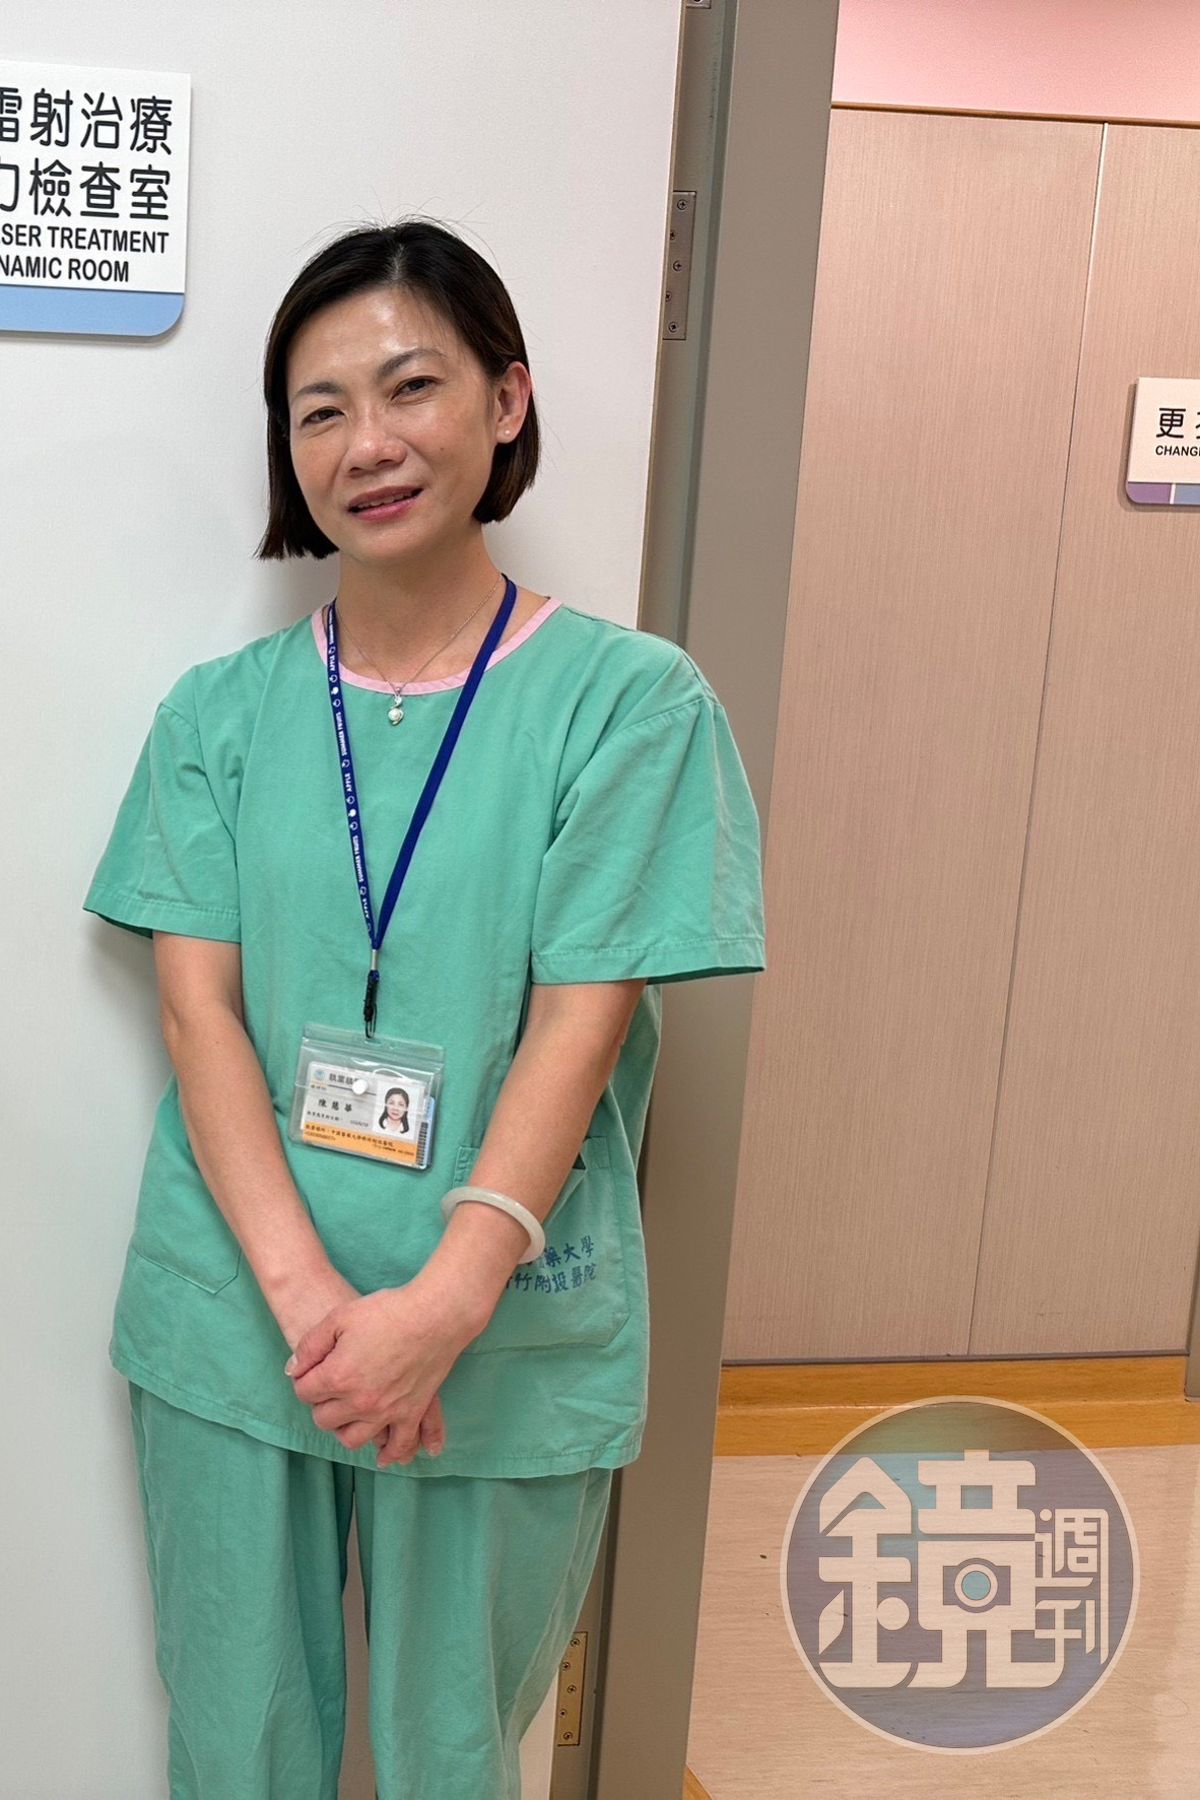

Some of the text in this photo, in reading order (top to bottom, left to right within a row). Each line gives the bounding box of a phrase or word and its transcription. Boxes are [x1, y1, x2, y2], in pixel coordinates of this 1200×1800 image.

[47, 226, 170, 254] TREATMENT
[67, 258, 130, 283] ROOM
[1155, 407, 1200, 440] 更
[1155, 444, 1200, 457] CHANG
[506, 1262, 598, 1294] 竹附設醫院
